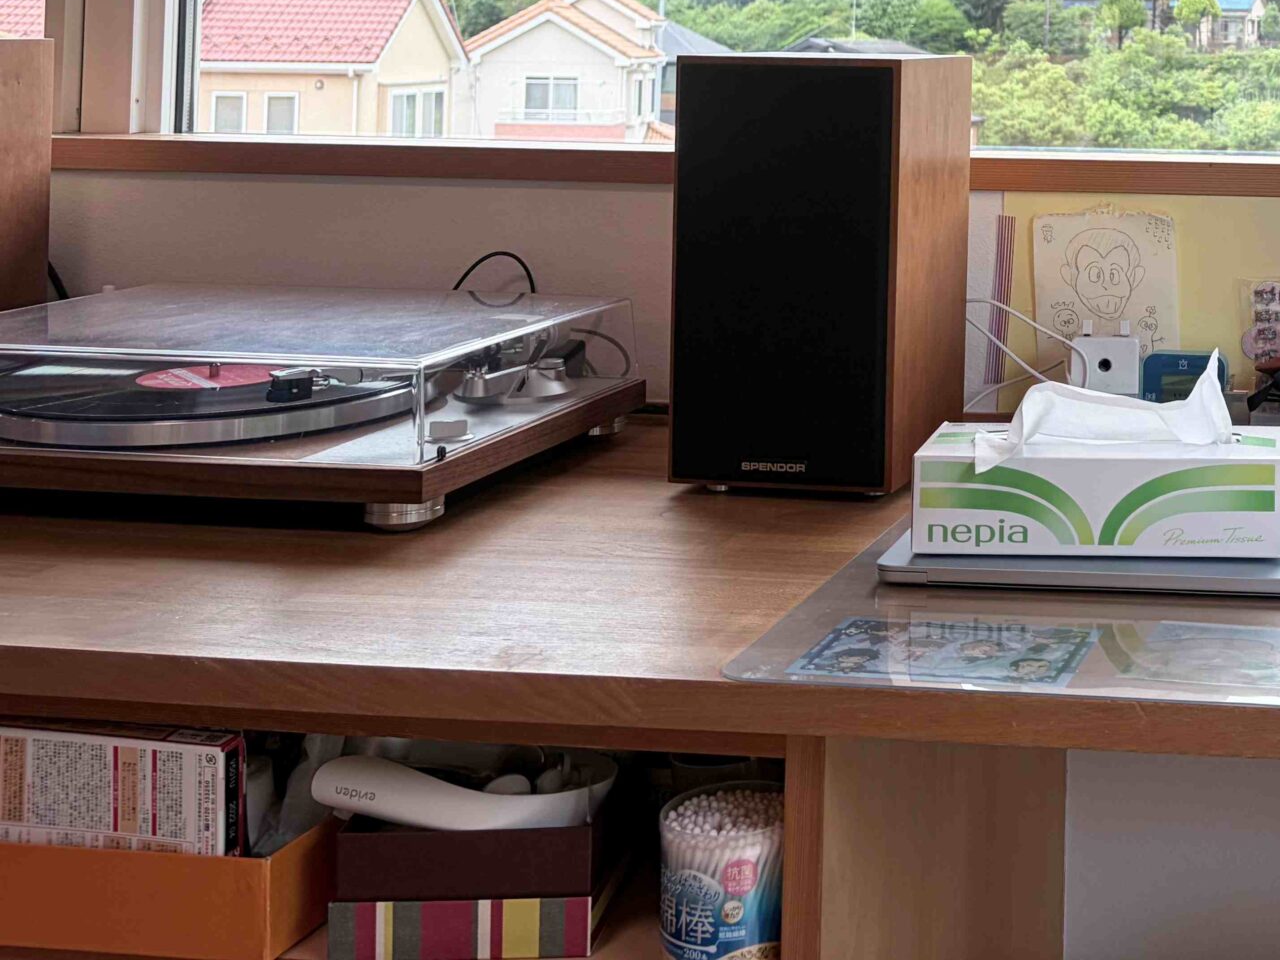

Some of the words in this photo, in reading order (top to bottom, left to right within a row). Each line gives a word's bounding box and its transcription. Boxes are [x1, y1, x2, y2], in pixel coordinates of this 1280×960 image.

[741, 461, 806, 473] SPENDOR
[927, 518, 1029, 548] nepia
[1162, 527, 1222, 547] Premium
[1222, 526, 1266, 544] Tissue
[335, 785, 376, 802] eviden
